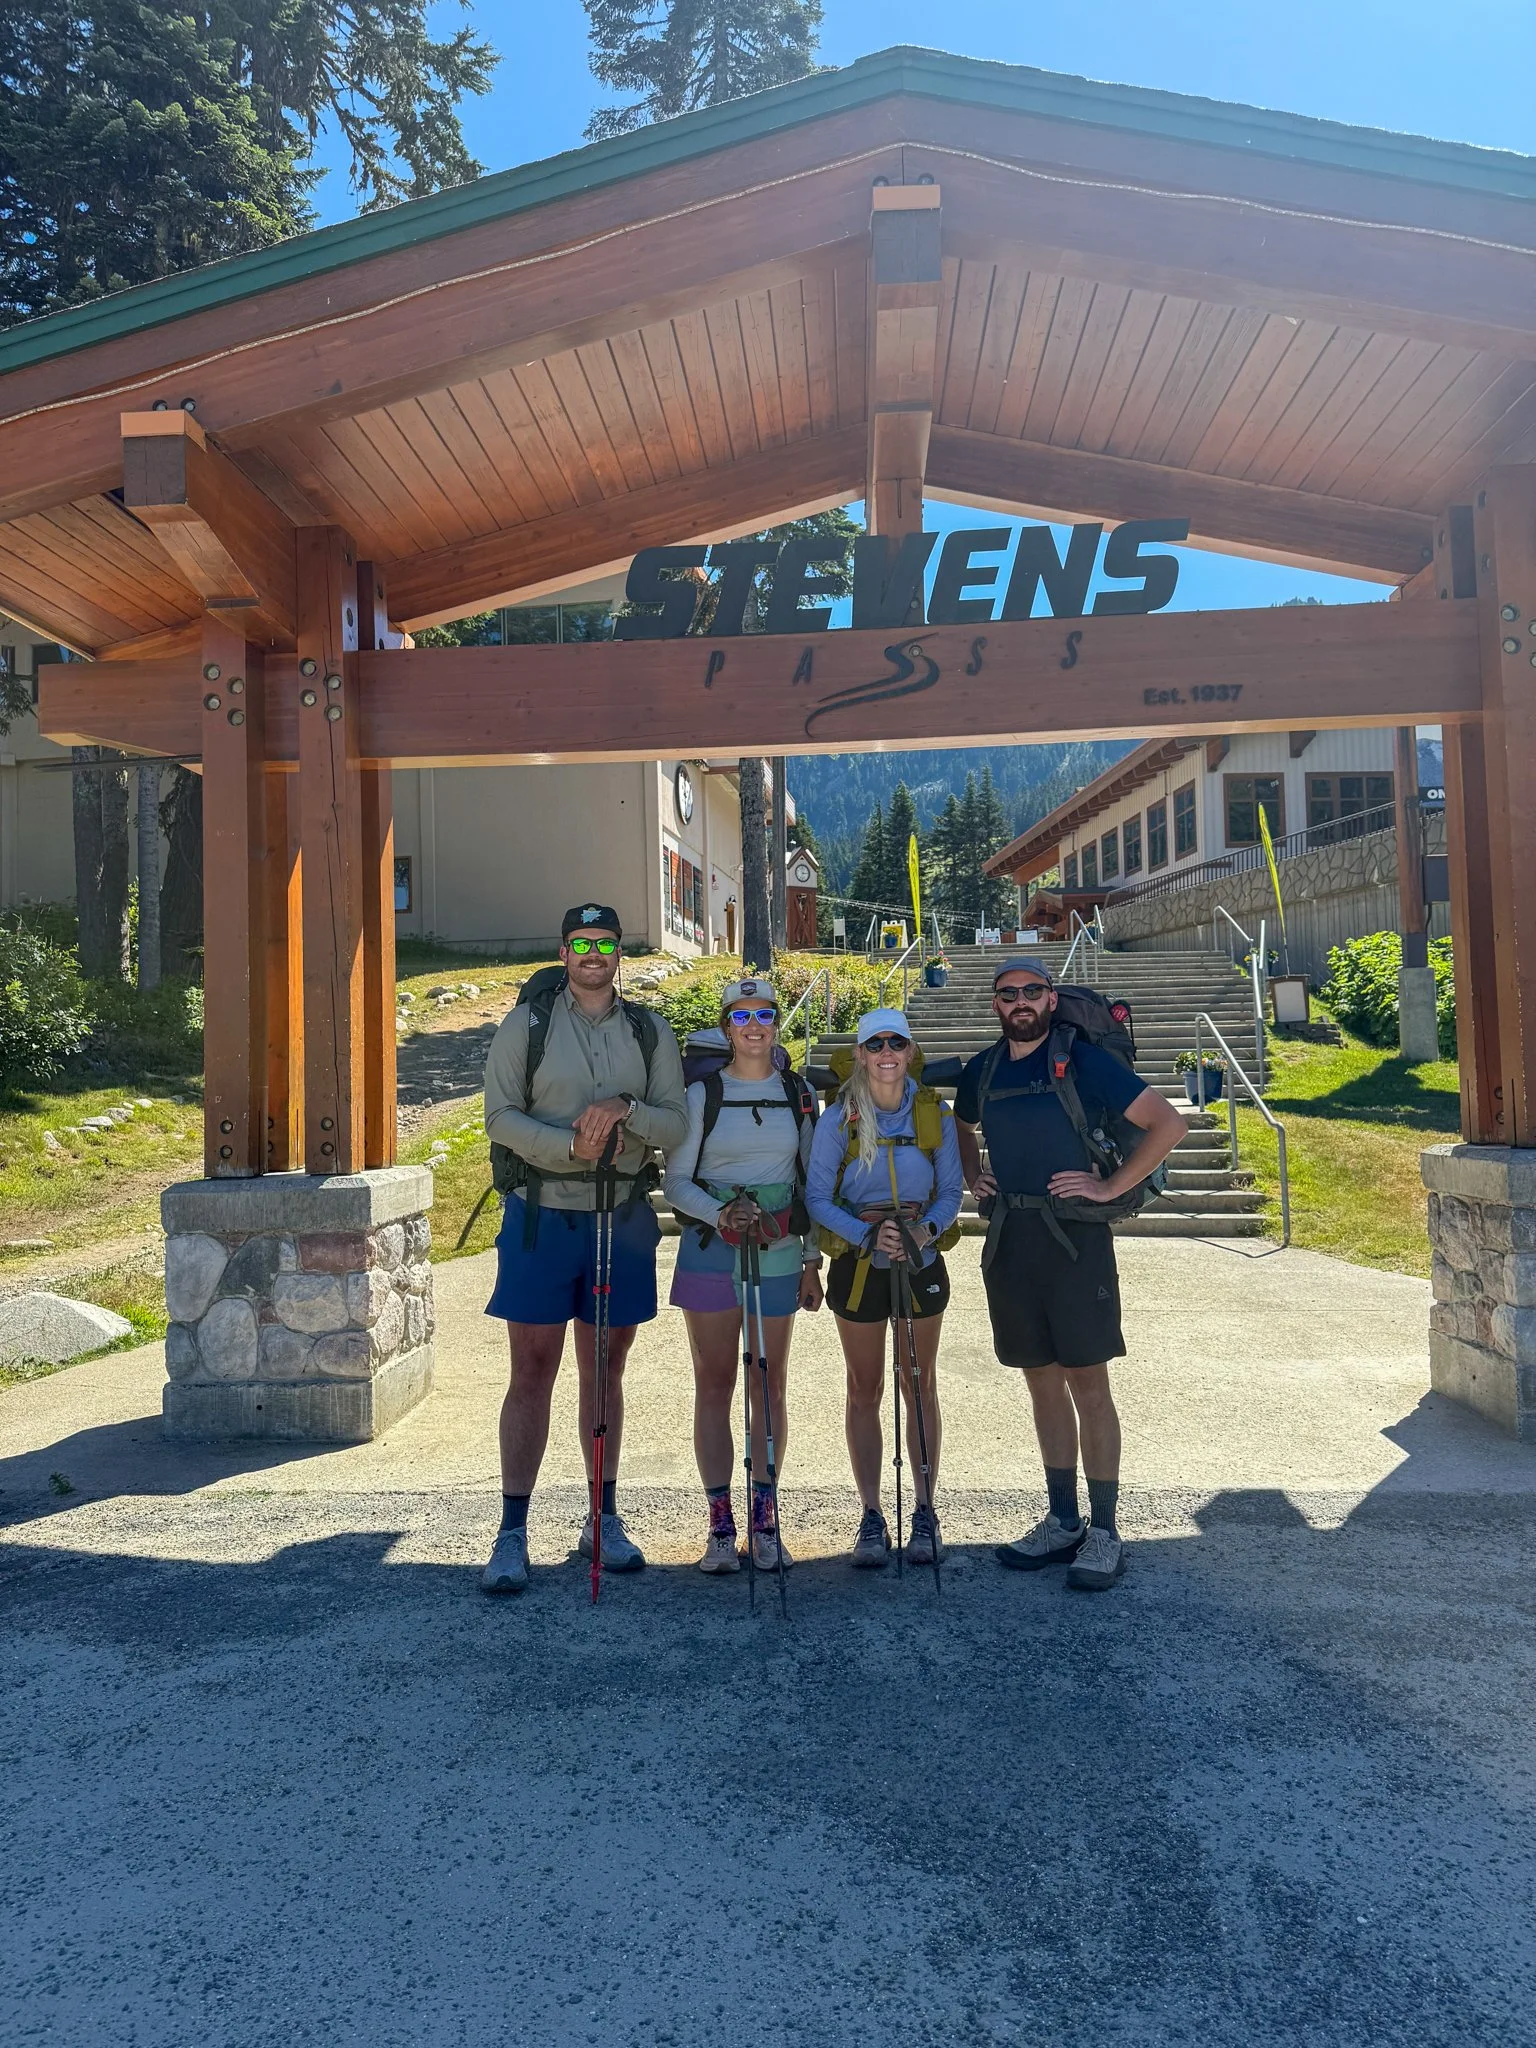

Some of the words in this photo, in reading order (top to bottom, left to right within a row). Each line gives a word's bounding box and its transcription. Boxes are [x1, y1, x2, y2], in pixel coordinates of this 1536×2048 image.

[614, 518, 1190, 641] STEVENS
[1143, 687, 1186, 706] Est.
[1190, 684, 1243, 704] 1937
